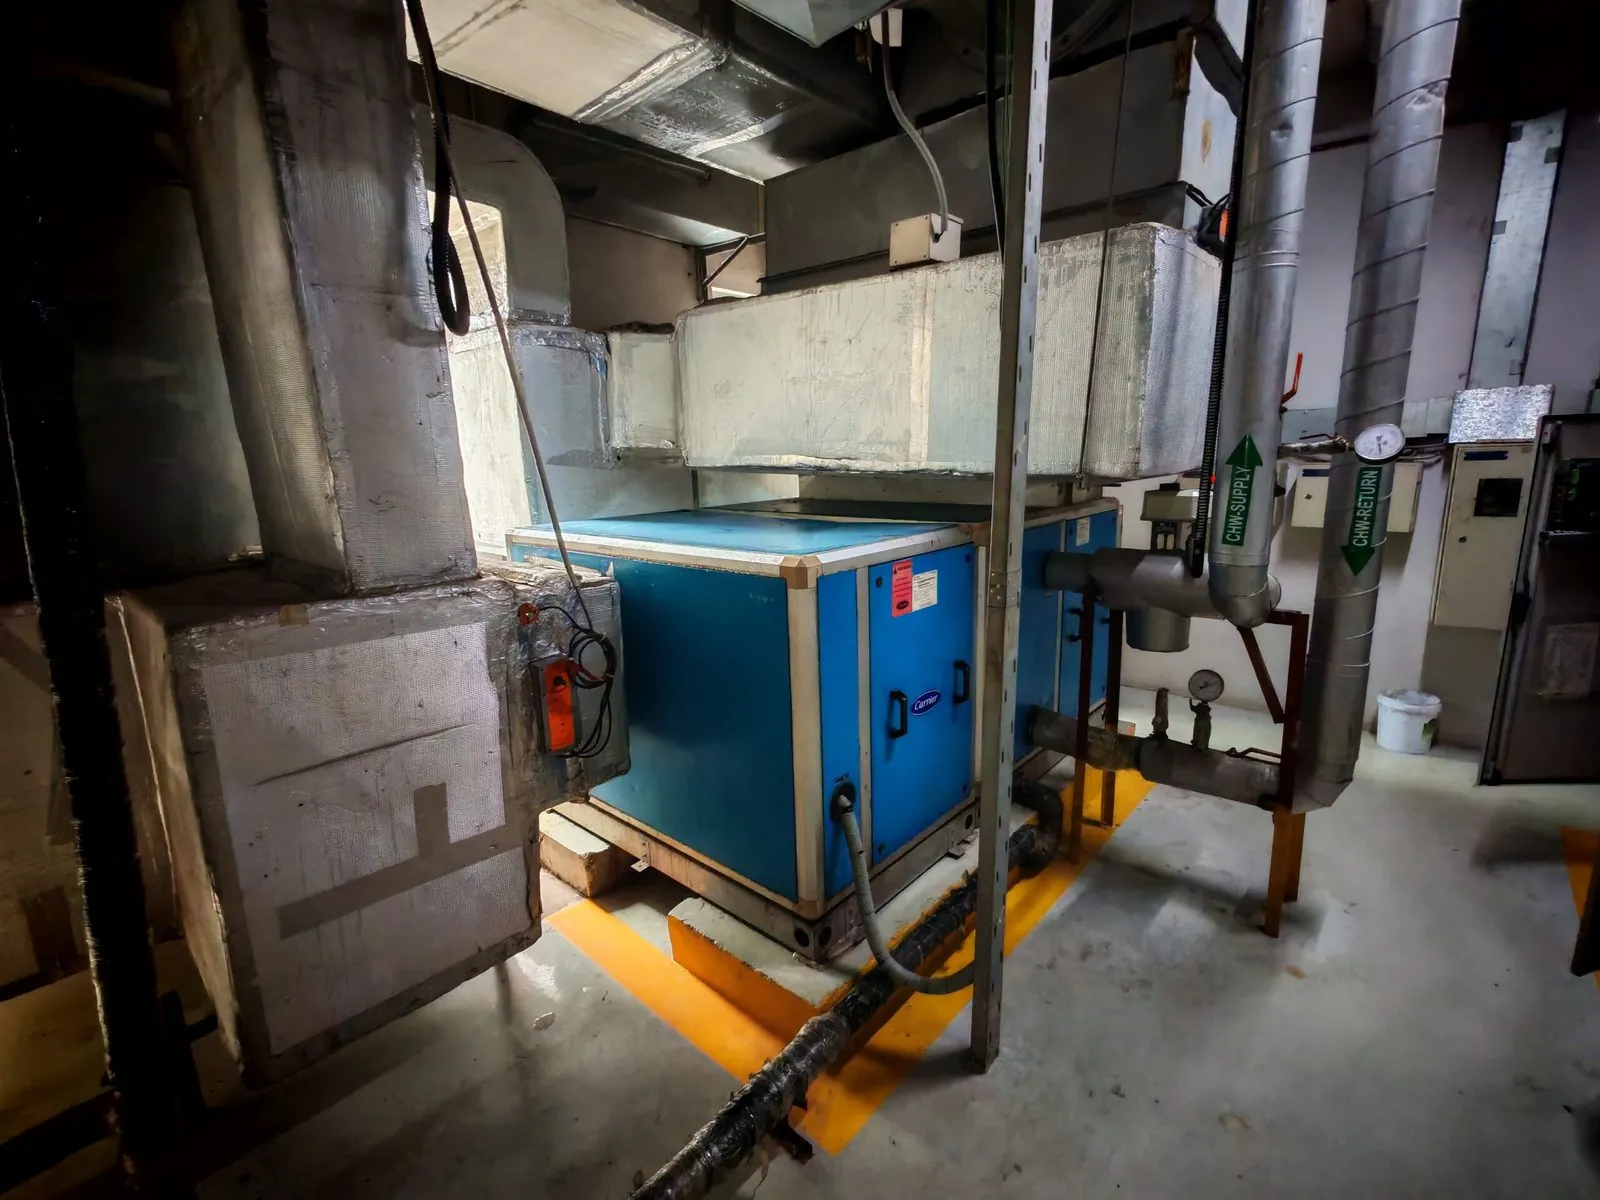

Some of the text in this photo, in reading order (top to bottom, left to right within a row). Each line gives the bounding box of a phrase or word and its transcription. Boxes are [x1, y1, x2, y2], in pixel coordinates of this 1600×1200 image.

[1226, 466, 1251, 542] CHW-SUPPLY
[1352, 470, 1379, 547] CHW-RETURN
[914, 692, 939, 711] Carrier
